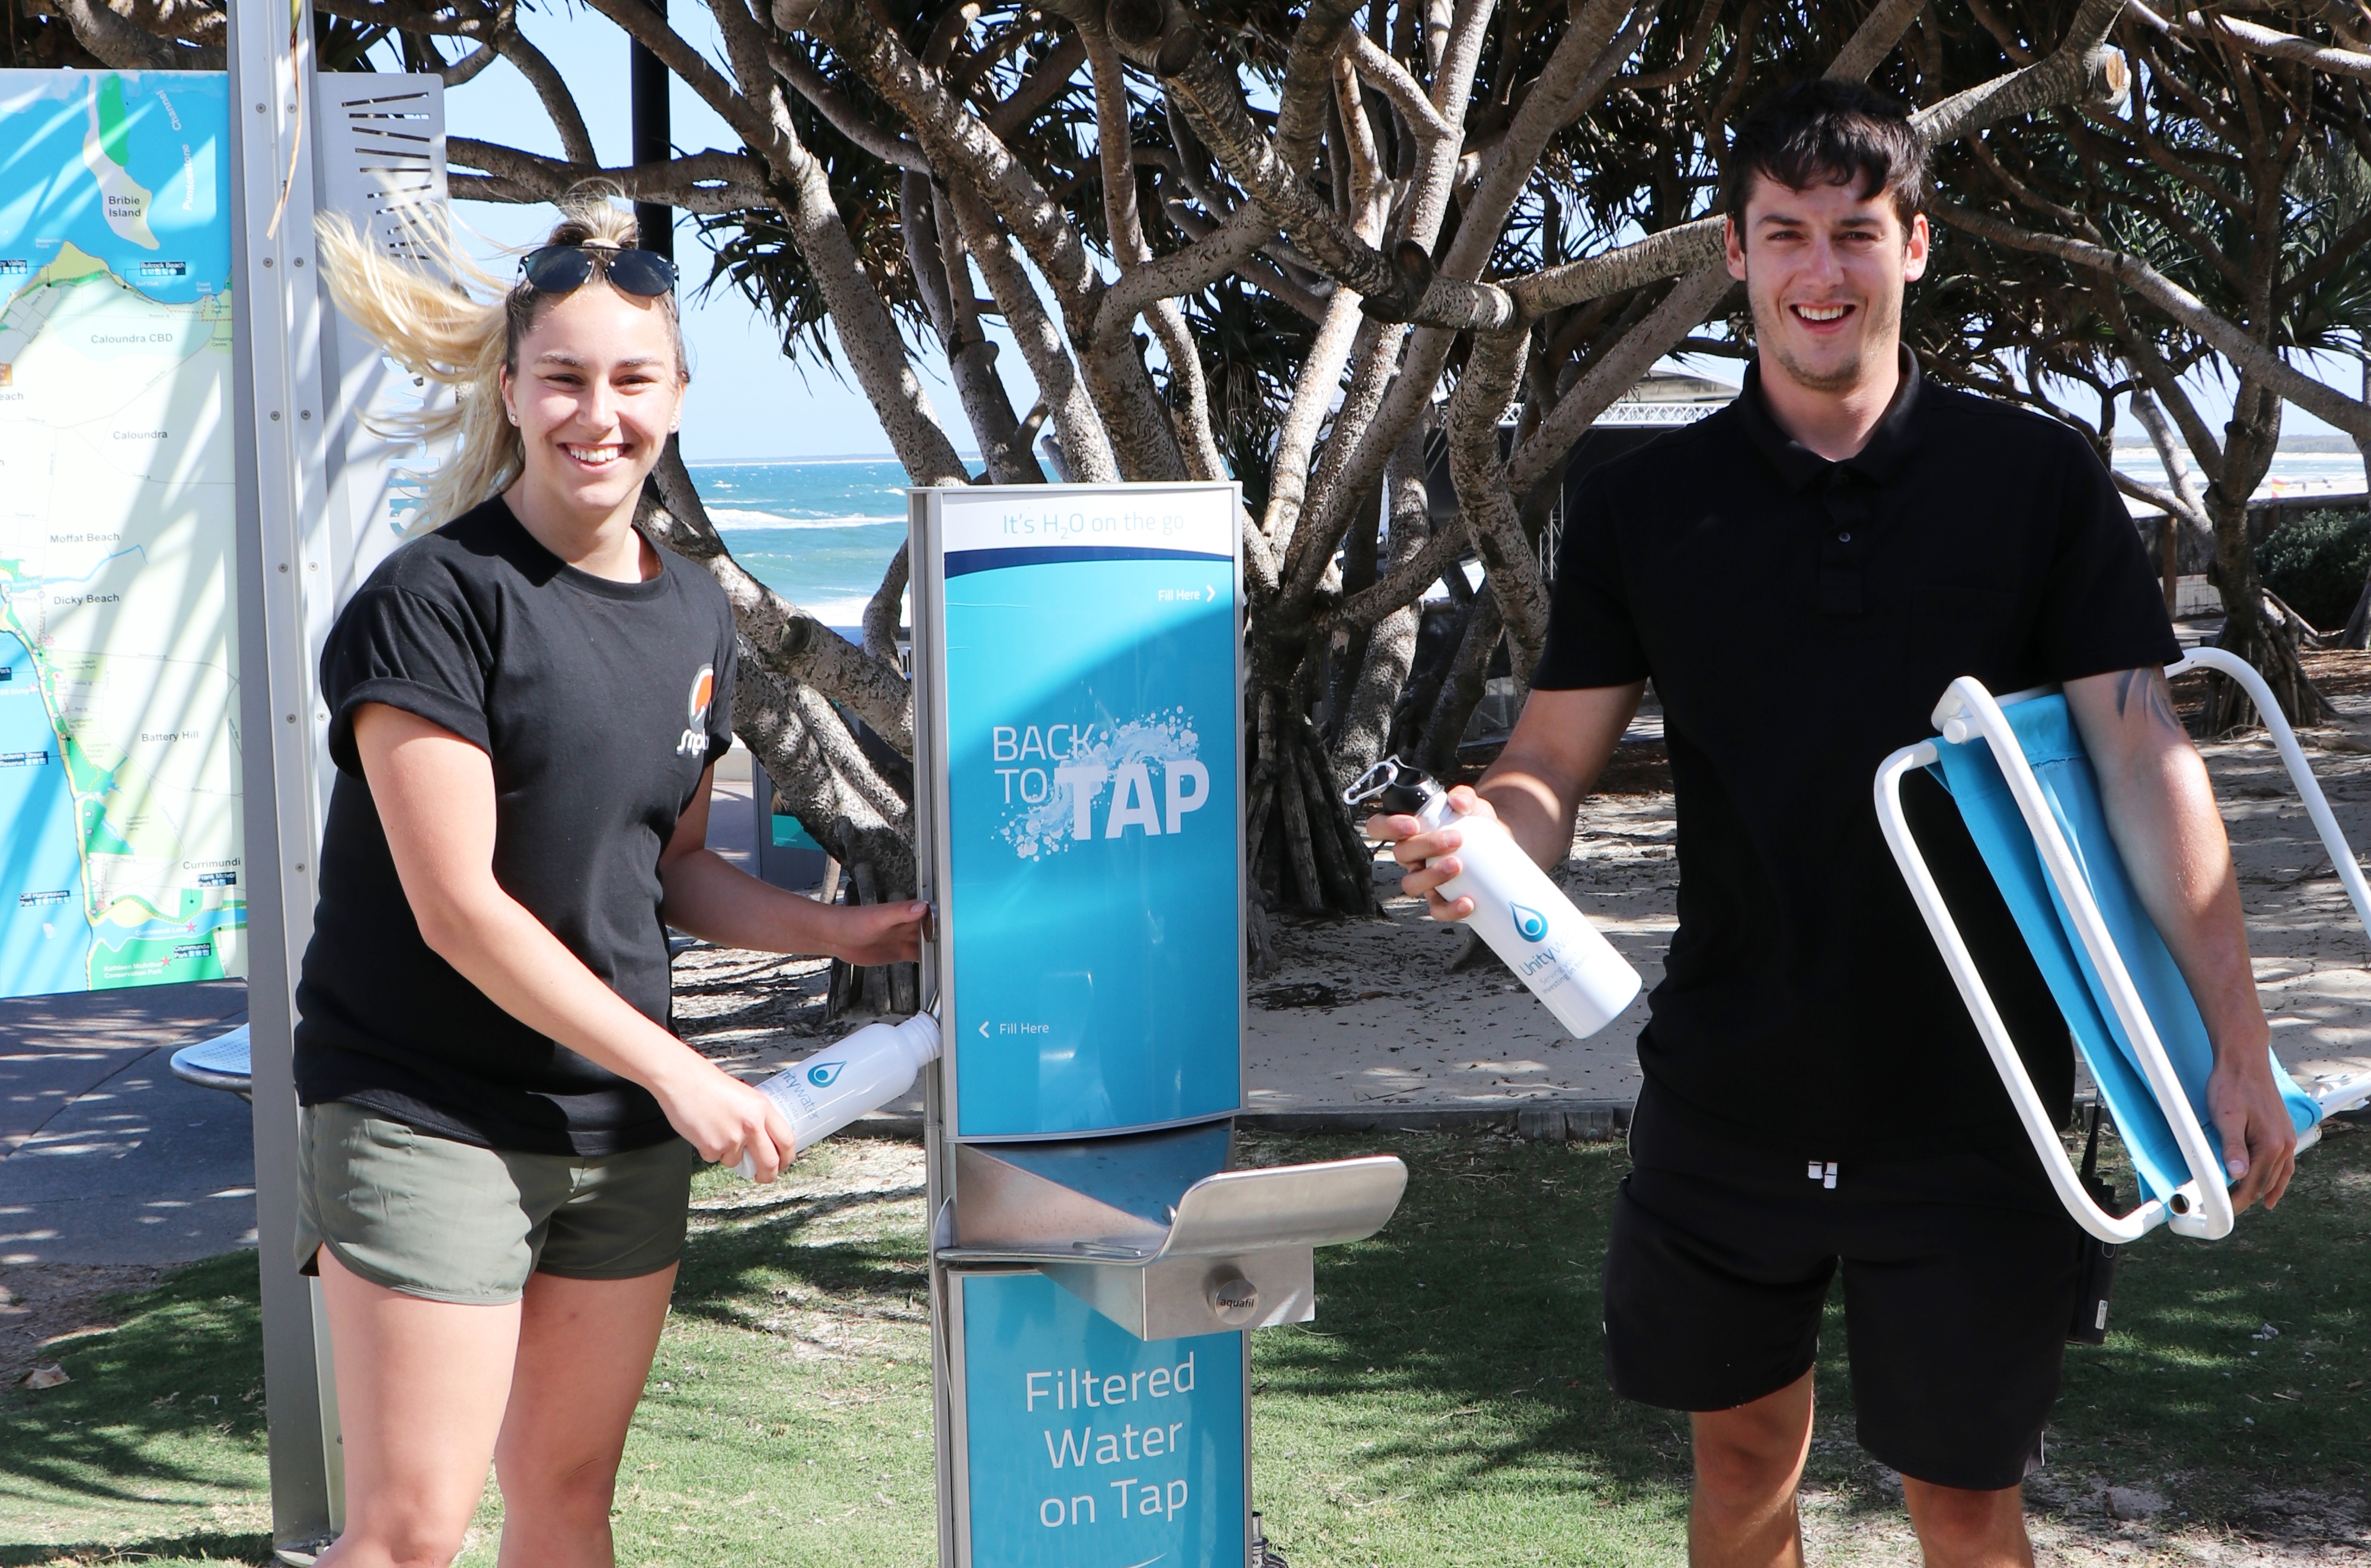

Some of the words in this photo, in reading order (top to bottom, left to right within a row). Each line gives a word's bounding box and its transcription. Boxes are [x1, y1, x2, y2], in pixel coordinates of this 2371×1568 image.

[156, 89, 182, 131] Channel
[181, 143, 195, 211] Pumicestone
[108, 196, 140, 205] Bribie
[108, 209, 141, 217] Island
[91, 334, 146, 344] Caloundra
[149, 334, 172, 343] CBD
[113, 430, 168, 440] Caloundra
[1003, 513, 1035, 534] It's
[1092, 516, 1117, 532] on
[1124, 511, 1156, 531] the
[1162, 514, 1184, 536] go
[50, 534, 83, 543] Moffat
[87, 532, 120, 542] Beach
[54, 596, 83, 606] Dicky
[87, 594, 119, 603] Beach
[1158, 589, 1174, 601] Fill
[1176, 588, 1200, 601] Here
[142, 733, 178, 743] Battery
[182, 731, 199, 739] Hill
[992, 724, 1095, 761] BACK
[994, 767, 1048, 804] TO
[1054, 759, 1210, 840] TAP
[183, 857, 241, 869] Currimundi
[999, 1023, 1017, 1035] Fill
[1021, 1023, 1049, 1034] Here
[1220, 1298, 1254, 1308] aquafil
[1026, 1351, 1194, 1412] Filtered
[1044, 1422, 1183, 1468] Water
[1040, 1495, 1095, 1528] on
[1110, 1479, 1188, 1522] Tap
